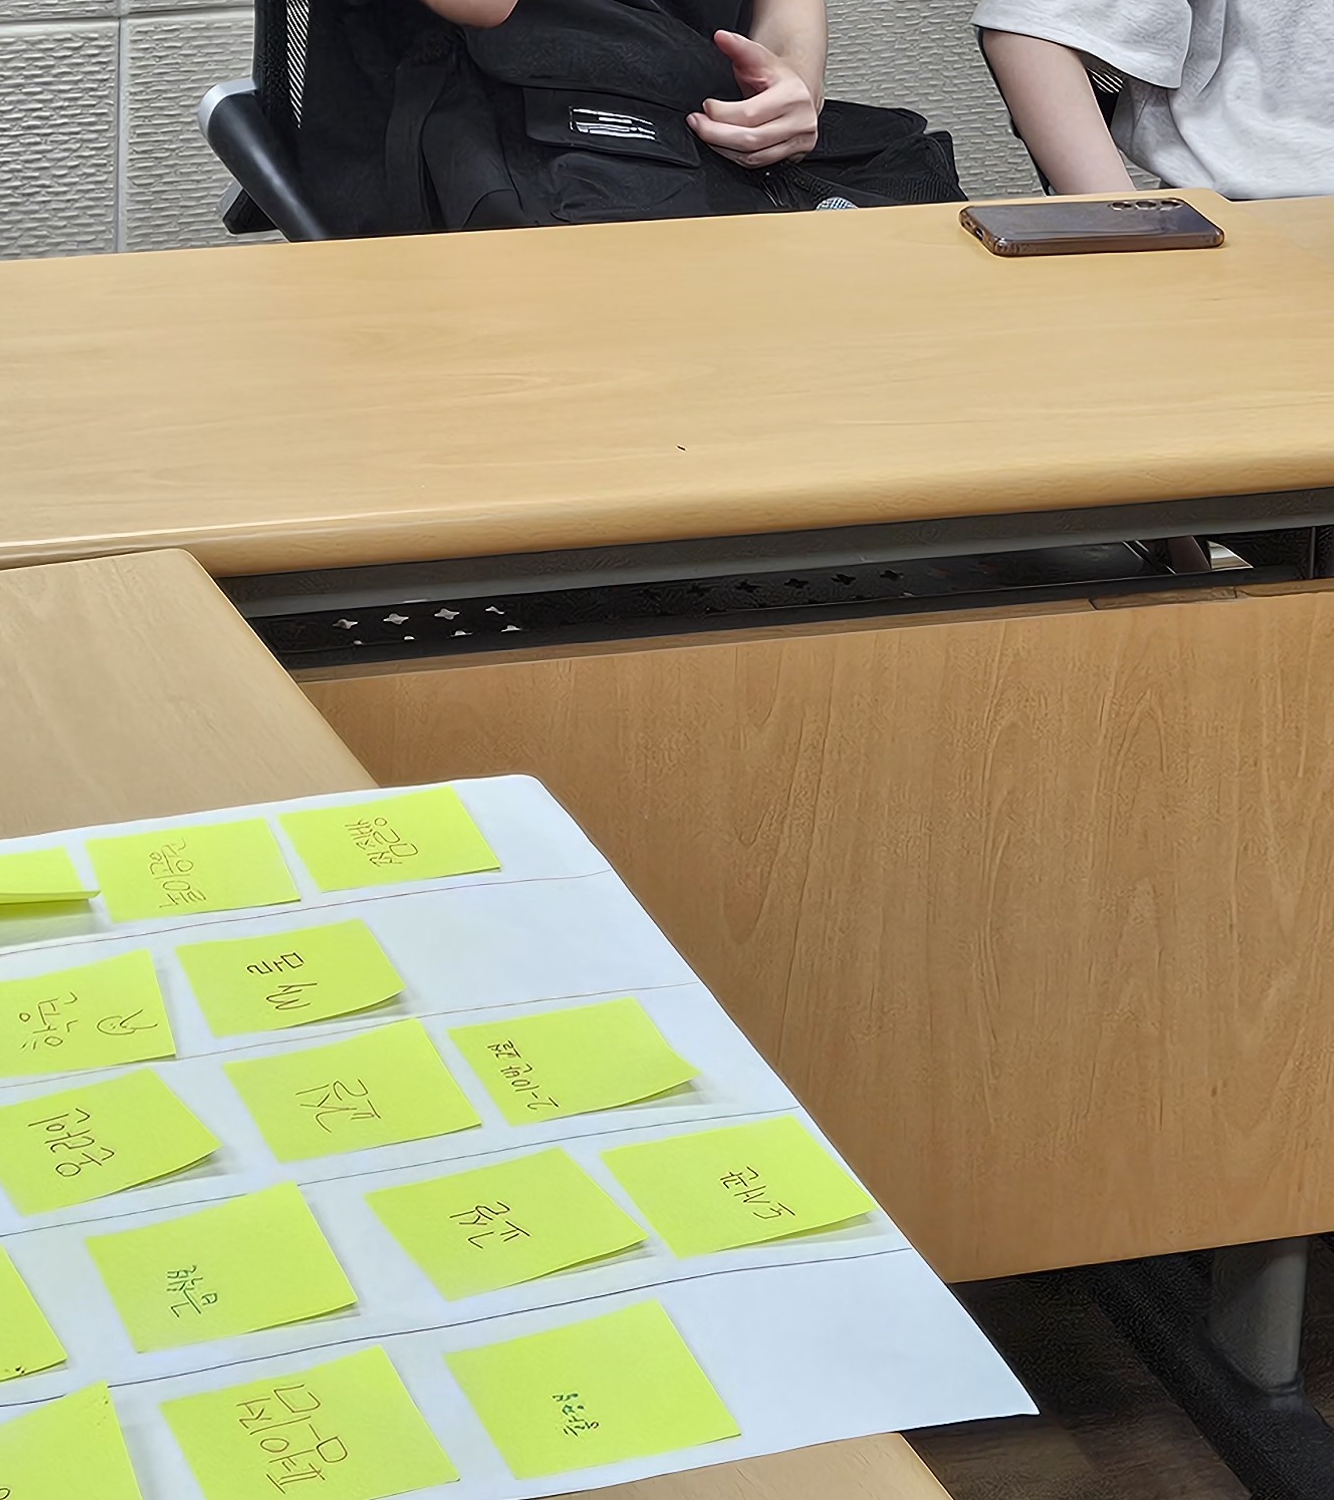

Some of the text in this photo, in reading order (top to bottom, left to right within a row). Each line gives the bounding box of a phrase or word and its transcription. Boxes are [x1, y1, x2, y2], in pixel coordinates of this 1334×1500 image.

[345, 818, 418, 867] 찜질방
[149, 837, 206, 908] 놀이공원
[247, 953, 317, 1010] My 룸
[19, 992, 78, 1050] 학원
[295, 1079, 381, 1133] 교실
[501, 1064, 559, 1110] 2-10반
[28, 1108, 114, 1177] 온라인
[720, 1166, 795, 1219] 도서관
[450, 1202, 530, 1249] 교실
